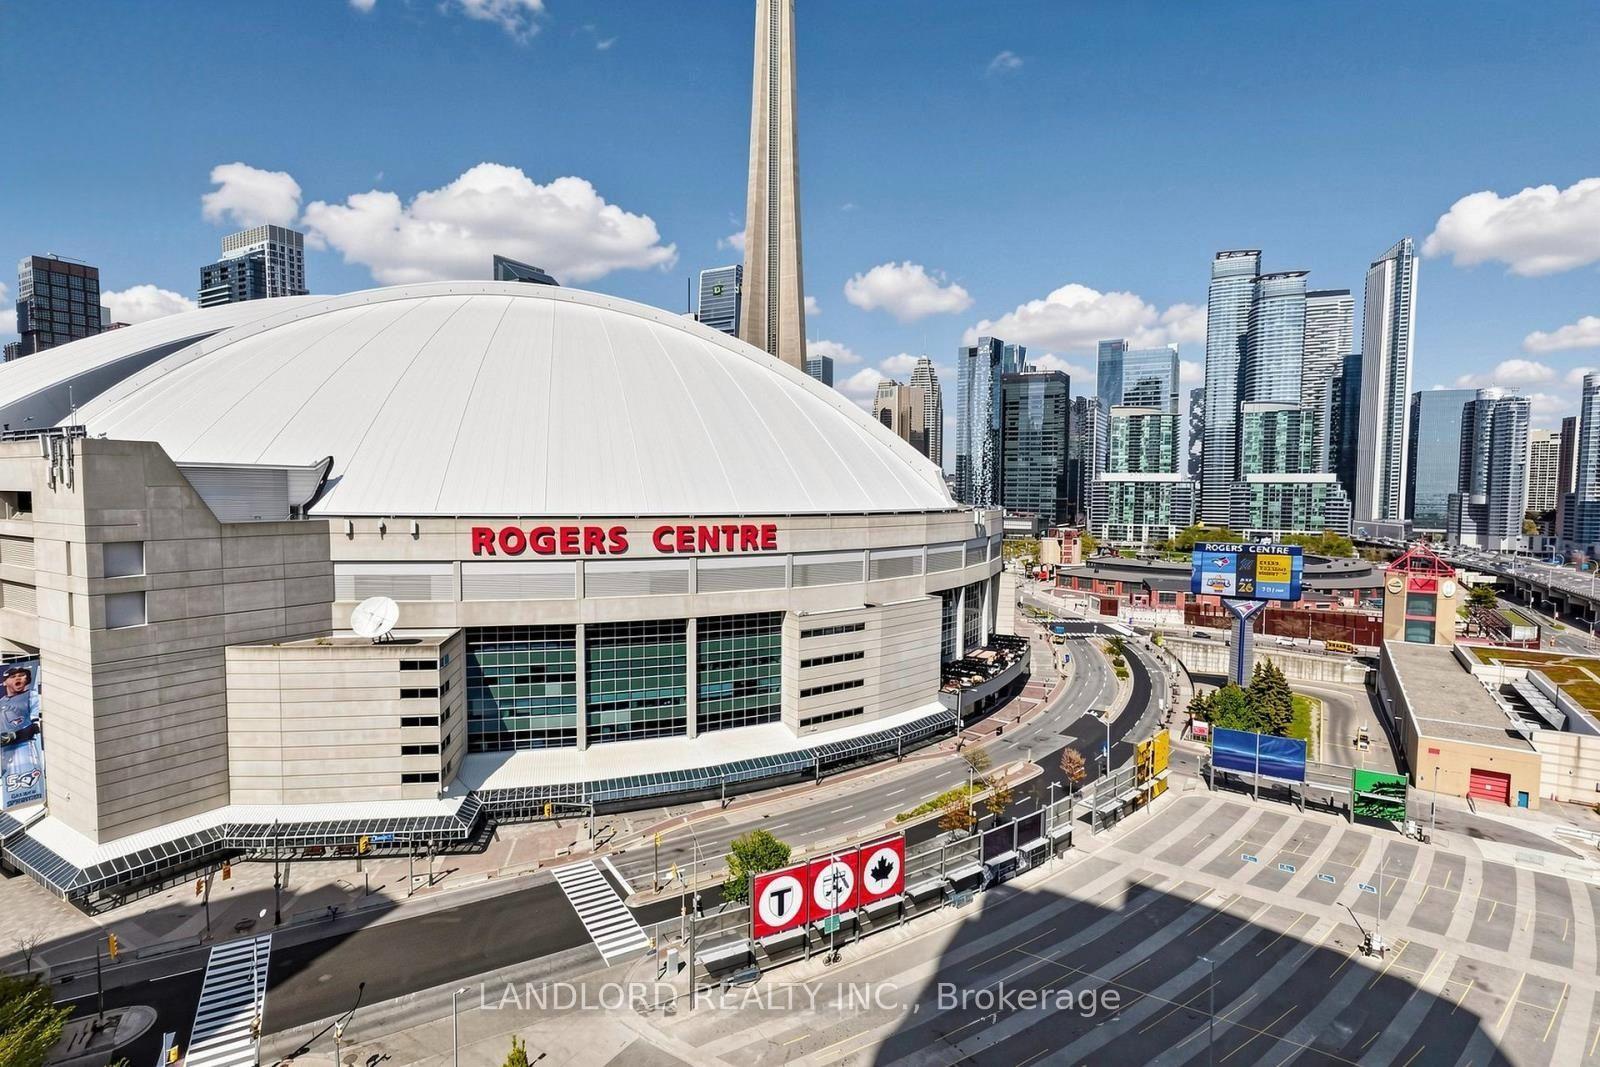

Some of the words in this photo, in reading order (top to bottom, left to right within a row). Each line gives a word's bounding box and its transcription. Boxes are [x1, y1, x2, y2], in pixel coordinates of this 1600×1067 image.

[472, 526, 629, 556] ROGERS
[652, 524, 778, 555] CENTRE
[1205, 543, 1243, 552] ROGERS
[1249, 545, 1290, 554] CENTRE
[1238, 582, 1254, 593] 26
[770, 887, 792, 917] T
